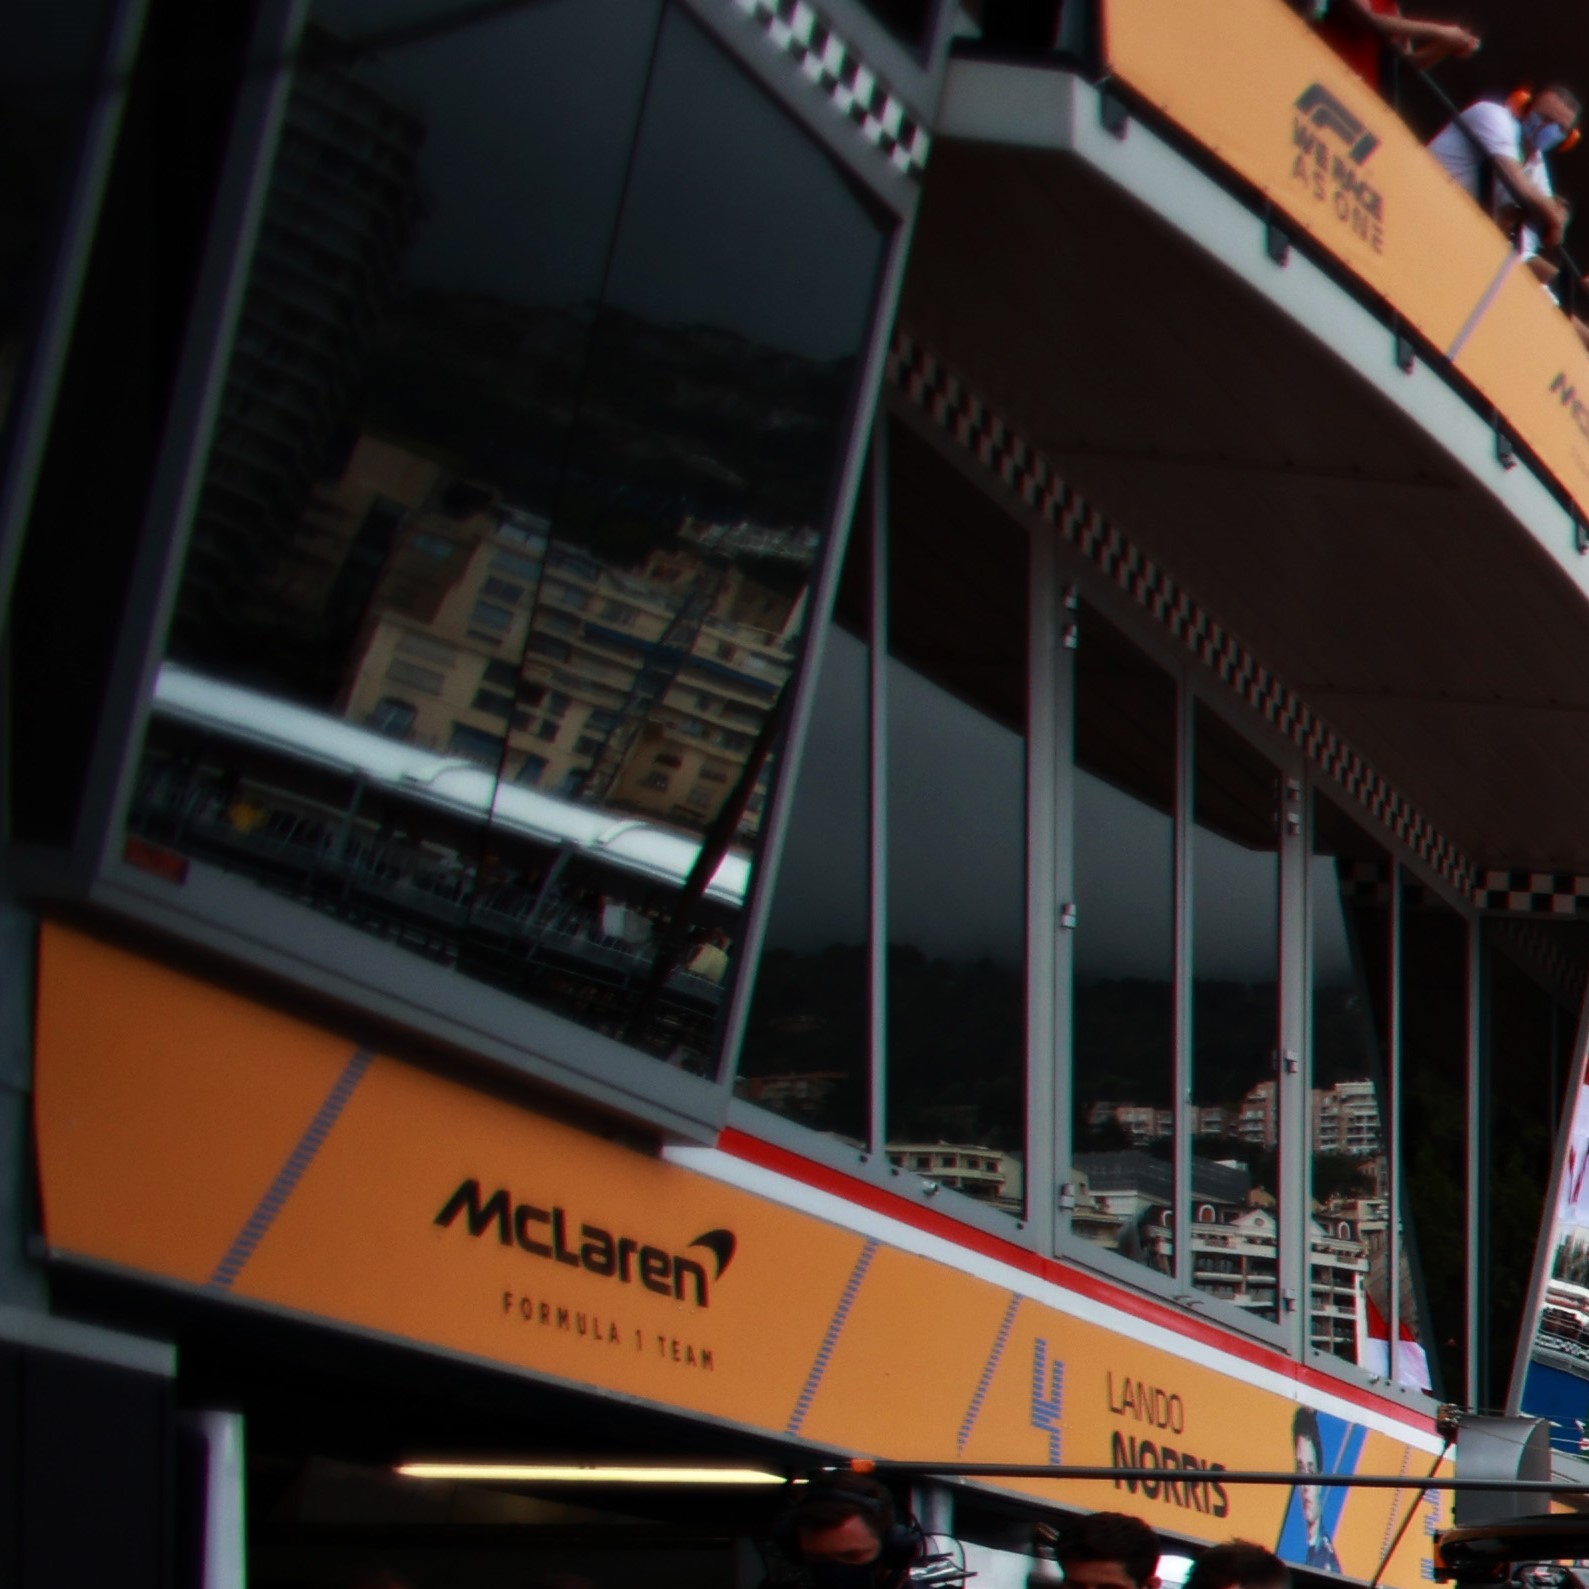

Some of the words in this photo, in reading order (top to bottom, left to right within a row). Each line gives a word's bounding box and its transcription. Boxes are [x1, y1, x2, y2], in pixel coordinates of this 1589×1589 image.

[1293, 116, 1328, 172] WE
[433, 1178, 712, 1308] McLaren
[502, 1290, 620, 1346] FORMULA
[634, 1329, 643, 1351] 1
[657, 1336, 714, 1372] TEAM
[1107, 1371, 1185, 1435] LANDO
[1112, 1430, 1230, 1519] NORRIS
